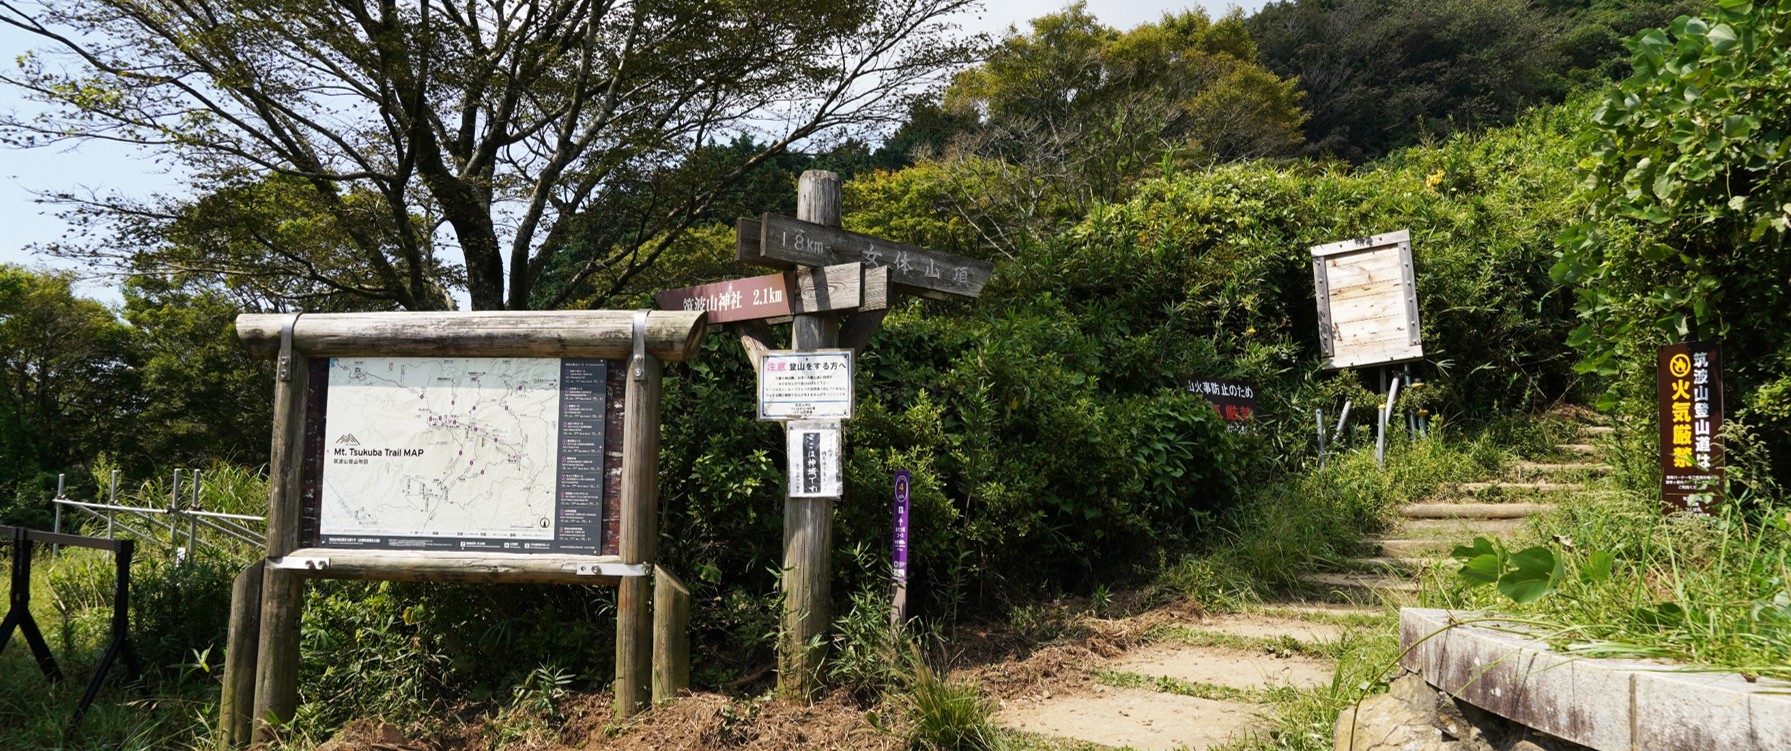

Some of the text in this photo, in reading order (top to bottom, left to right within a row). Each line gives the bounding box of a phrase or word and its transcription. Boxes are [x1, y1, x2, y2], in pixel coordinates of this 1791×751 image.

[683, 286, 783, 312] 筑波山神社 2.1km
[767, 362, 847, 372] 注意 登山をする方へ
[1693, 352, 1711, 471] 筑波山登山道は
[1671, 379, 1693, 468] 火気厳禁
[333, 448, 424, 457] Mt. Tsukuba Trail MAP
[899, 483, 904, 491] 4
